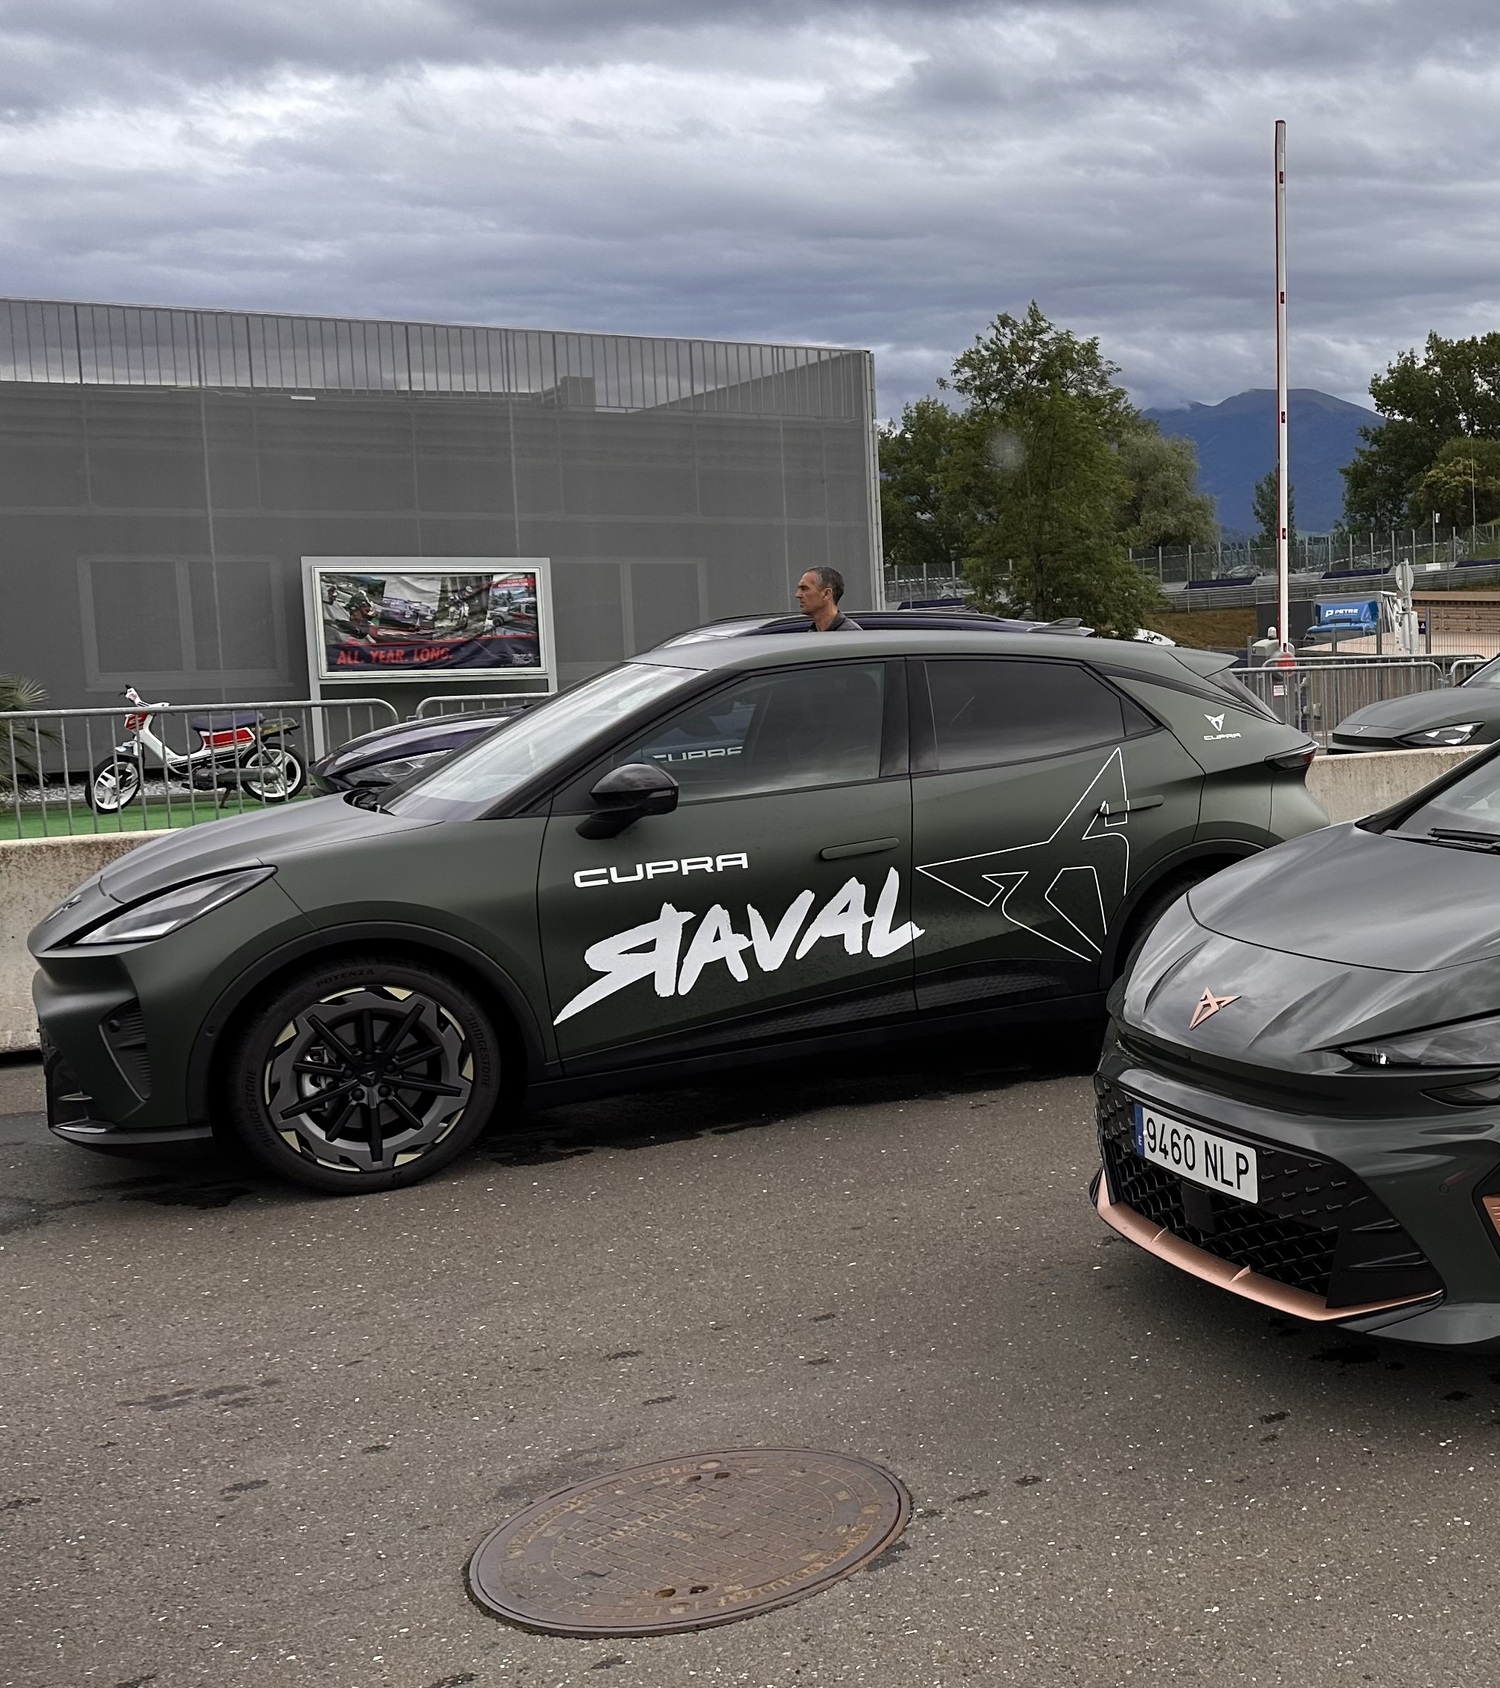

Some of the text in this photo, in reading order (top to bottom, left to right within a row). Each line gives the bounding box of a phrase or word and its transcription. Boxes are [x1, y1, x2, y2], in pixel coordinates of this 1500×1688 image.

[336, 647, 453, 664] ALL. YEAR. LONG.
[1203, 733, 1242, 741] CUPRA
[573, 852, 748, 888] CUPRA
[316, 968, 376, 987] POTENZA
[464, 1011, 493, 1090] BRIDGESTONE
[244, 1070, 288, 1148] BRIDGESTONE
[1146, 1117, 1249, 1190] 9460 NLP
